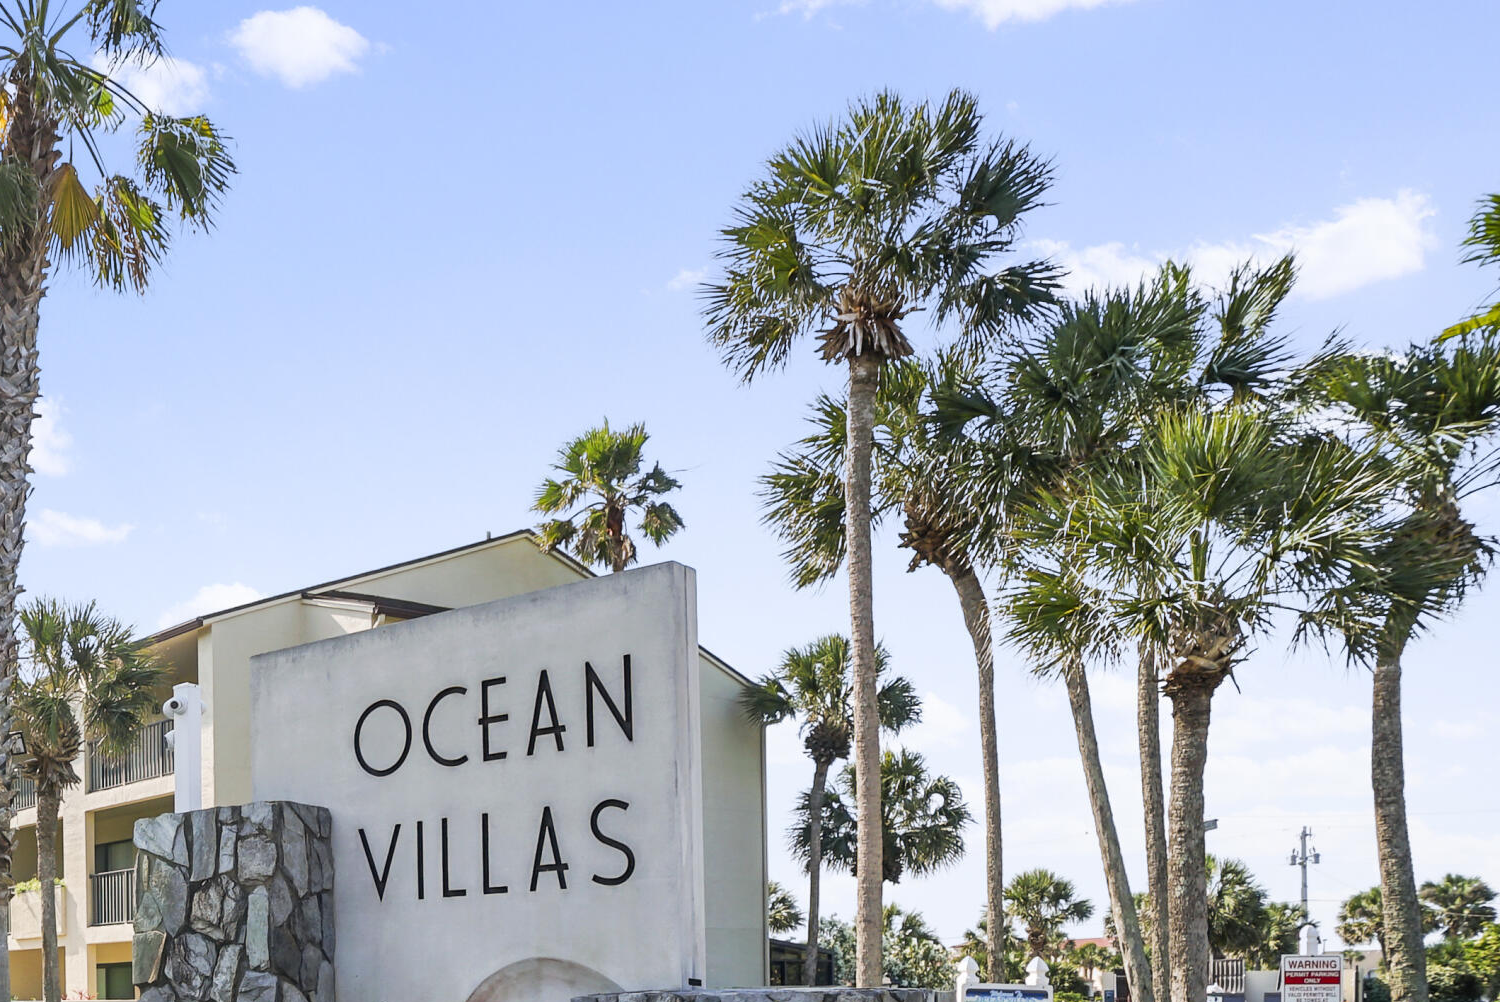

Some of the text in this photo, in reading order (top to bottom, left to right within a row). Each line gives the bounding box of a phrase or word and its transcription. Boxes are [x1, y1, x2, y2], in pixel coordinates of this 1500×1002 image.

[354, 654, 633, 777] OCEAN
[358, 799, 635, 902] VILLAS
[1288, 960, 1337, 969] WARNING
